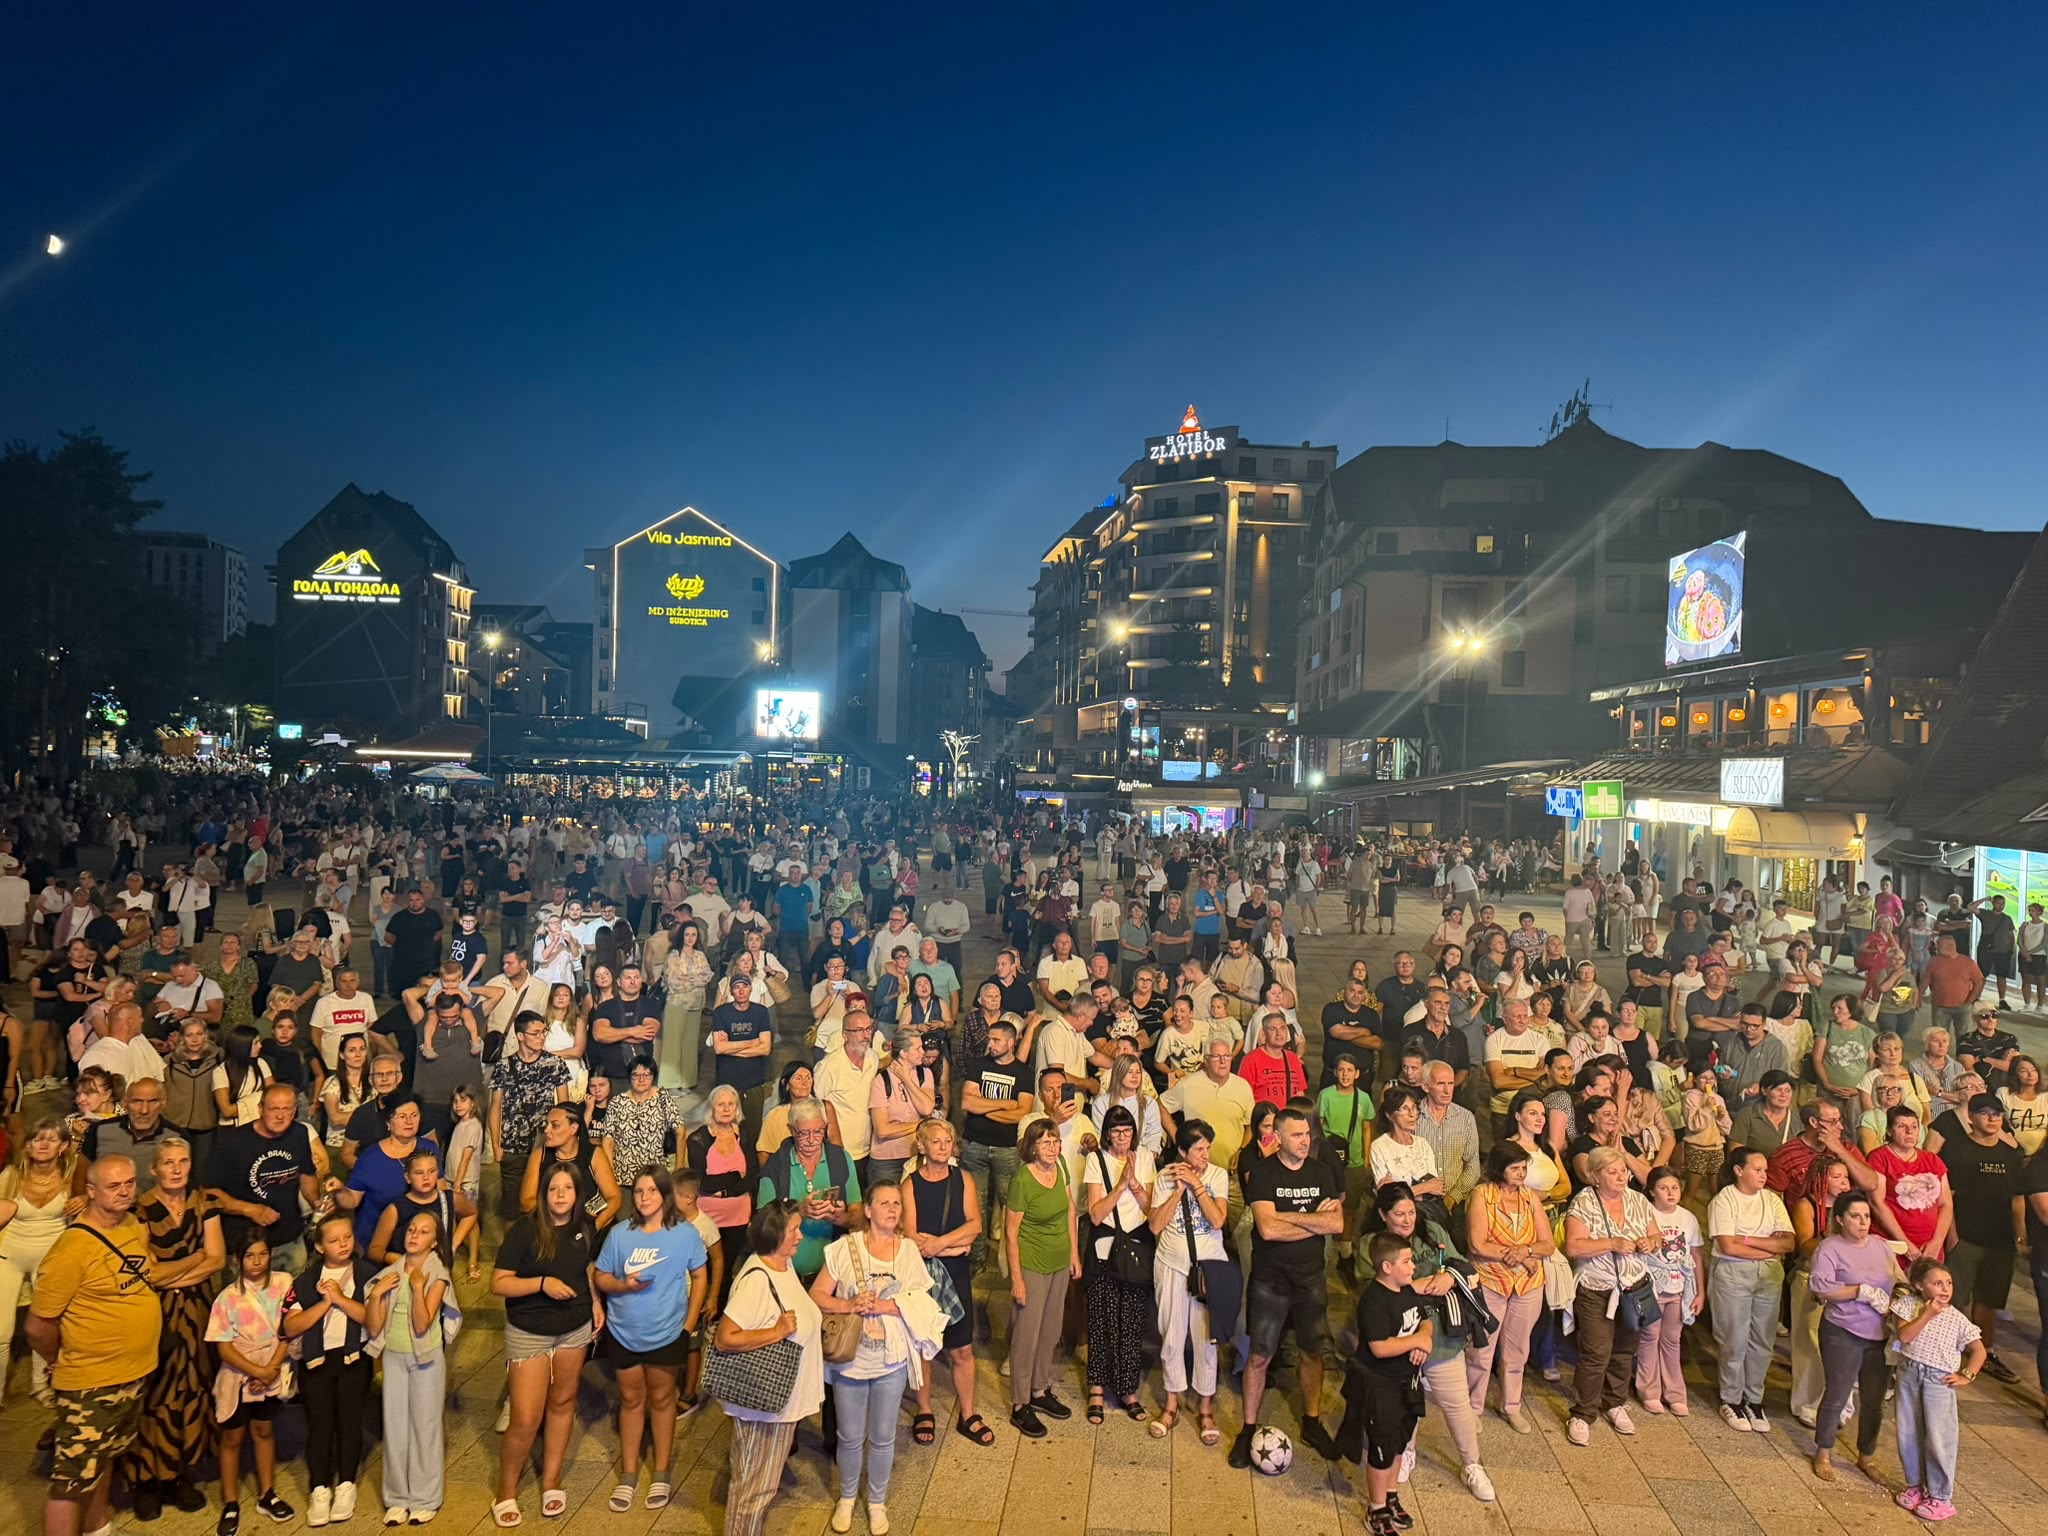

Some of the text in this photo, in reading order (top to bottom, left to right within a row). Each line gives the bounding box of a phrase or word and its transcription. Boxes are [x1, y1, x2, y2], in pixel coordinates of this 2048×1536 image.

[1166, 431, 1210, 446] HOTEL
[1150, 437, 1226, 460] ZLATIBOR
[646, 531, 732, 546] Vila Jasmina
[293, 580, 400, 596] ГОЛД ГОНДОЛА
[648, 606, 729, 618] MD INŽENJERING
[669, 617, 708, 626] SUBOTICA
[1733, 775, 1770, 799] RUJNO
[985, 1081, 1009, 1100] TOKYO
[2009, 1107, 2045, 1132] EA7
[267, 1149, 293, 1161] BRAND
[249, 1154, 268, 1187] ORIGINAL
[252, 1186, 268, 1199] THE
[629, 1247, 660, 1264] NIKE
[1402, 1305, 1420, 1331] NIKE
